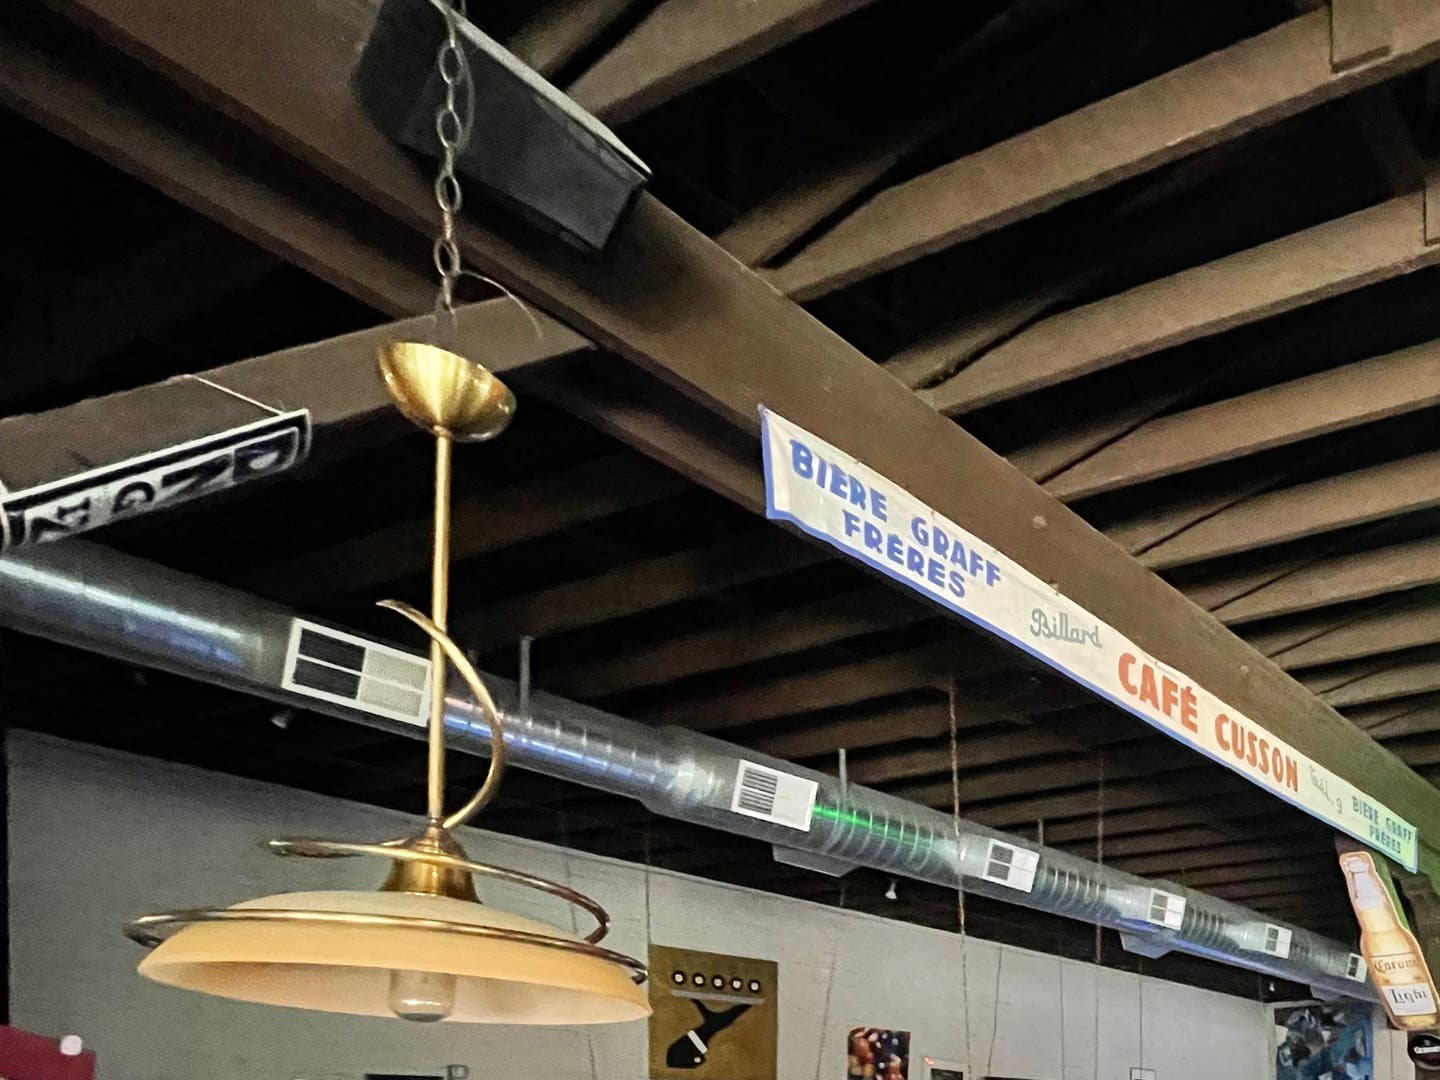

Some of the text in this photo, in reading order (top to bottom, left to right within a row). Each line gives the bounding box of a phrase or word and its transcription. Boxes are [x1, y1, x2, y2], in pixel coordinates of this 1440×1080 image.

[911, 516, 1001, 588] GRAFF
[1029, 607, 1103, 649] Billard
[1117, 651, 1299, 793] CAFÉ CUSSON
